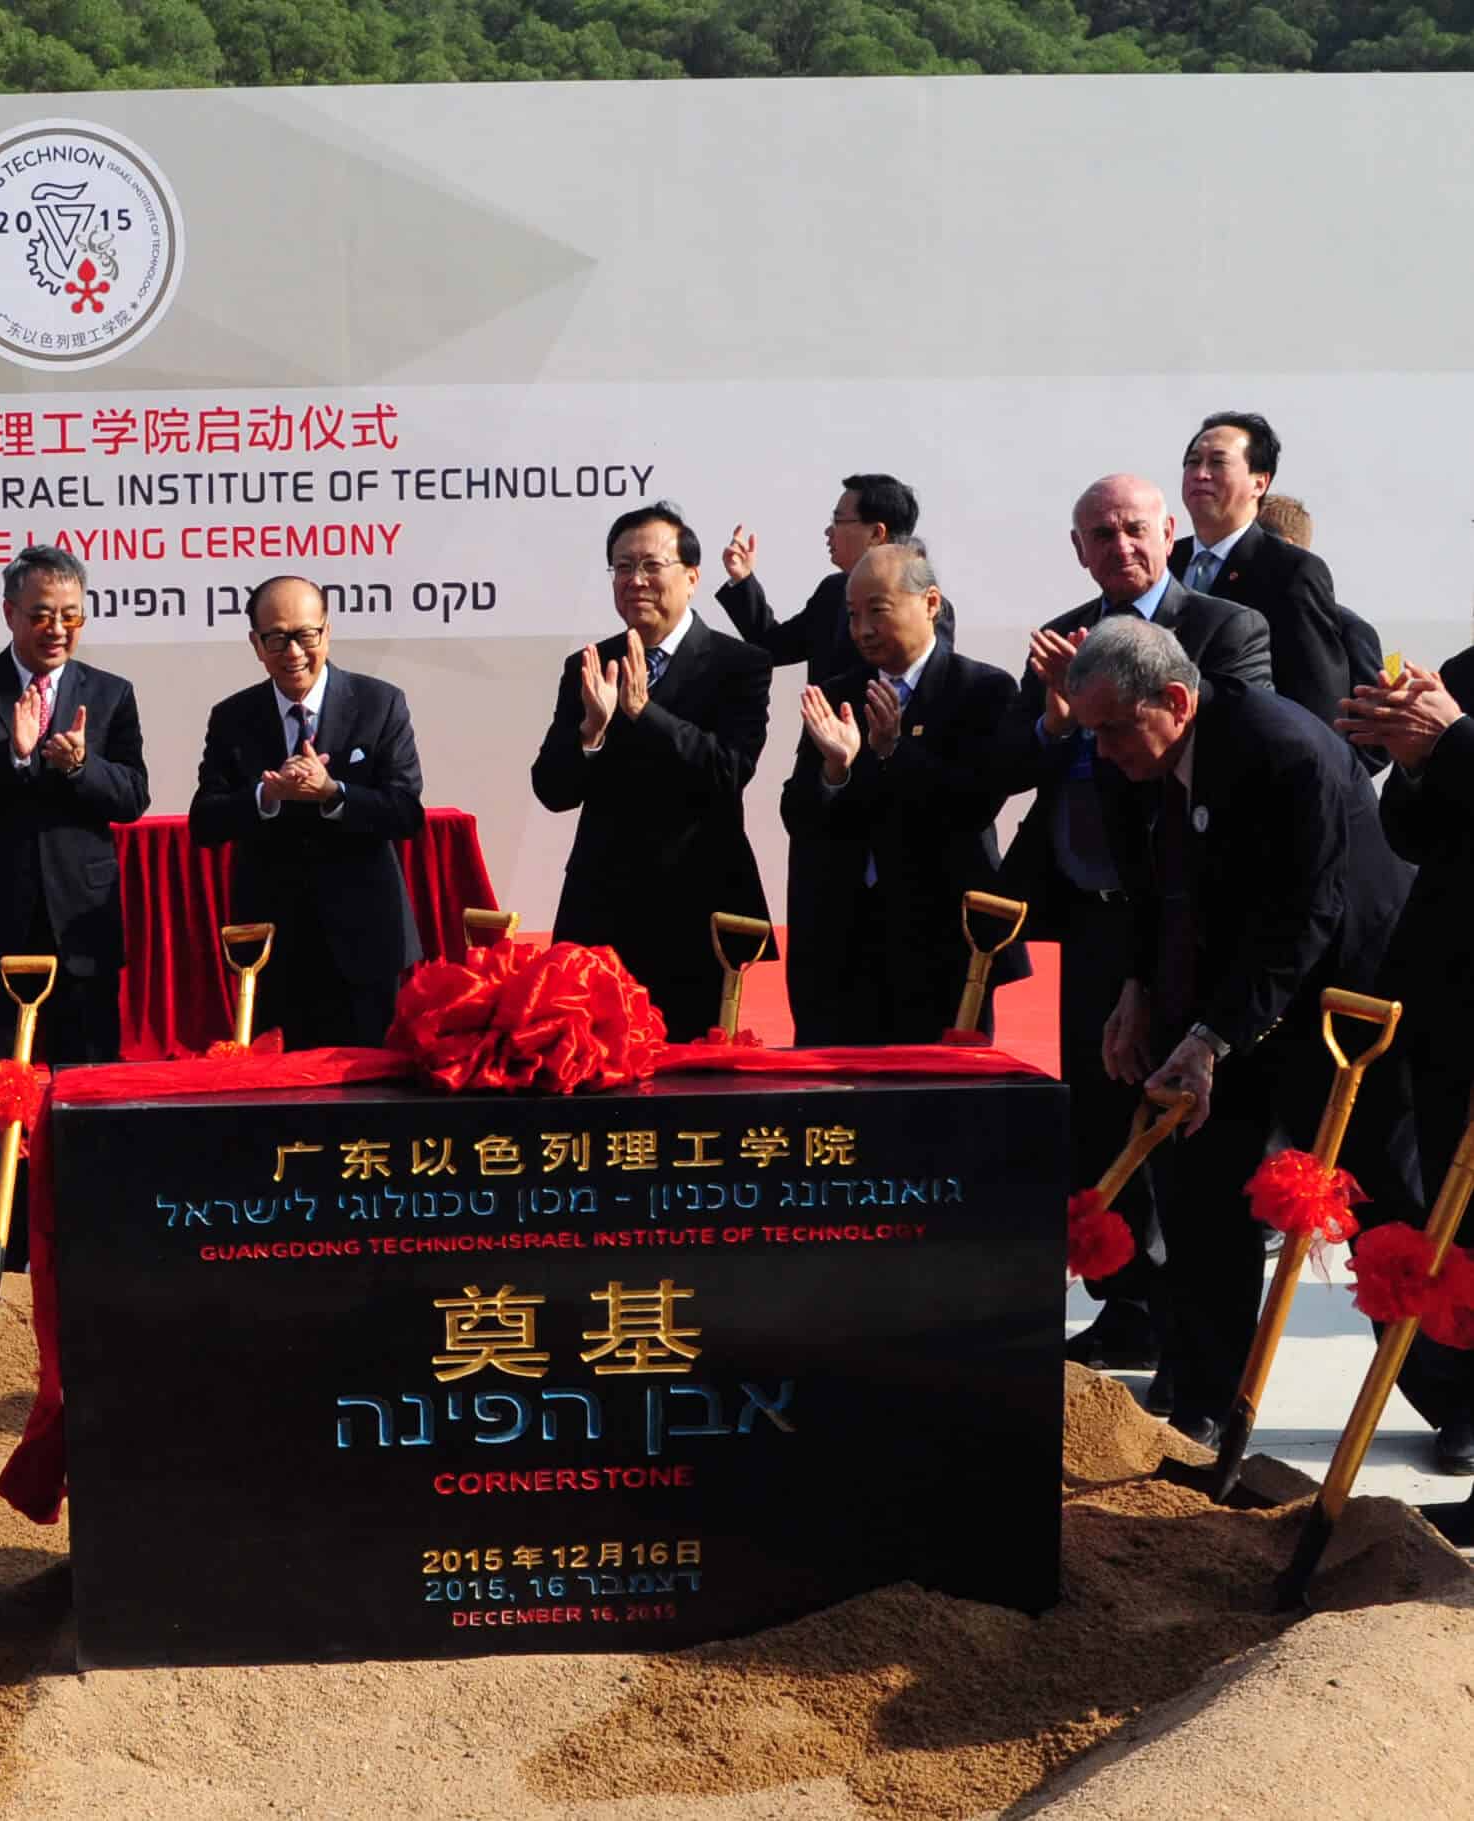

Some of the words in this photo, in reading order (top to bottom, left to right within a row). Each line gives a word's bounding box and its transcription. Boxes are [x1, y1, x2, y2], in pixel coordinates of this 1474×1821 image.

[1, 146, 105, 179] TECHNION
[107, 161, 132, 185] ISRAEL
[131, 182, 158, 223] INSTITUTE
[137, 239, 160, 299] TECHNOLOGY
[118, 471, 314, 507] INSTITUTE
[329, 469, 379, 502] OF
[391, 465, 655, 499] TECHNOLOGY
[180, 523, 402, 560] CEREMONY
[412, 581, 496, 624] טקס
[272, 1125, 858, 1182] 广东以色列理工学院
[156, 1187, 318, 1226] לישראל
[517, 1185, 599, 1222] מכון
[199, 1239, 362, 1262] GUANGDONG
[367, 1231, 586, 1256] TECHNION-ISRAEL
[593, 1226, 716, 1249] INSTITUTE
[722, 1225, 755, 1244] OF
[761, 1221, 927, 1242] TECHNOLOGY
[431, 1279, 702, 1382] 奠基
[336, 1391, 603, 1449] הפינה
[645, 1379, 797, 1456] אבן
[432, 1465, 694, 1496] CORNERSTONE
[529, 1575, 566, 1599] 16
[451, 1605, 583, 1629] DECEMBER
[590, 1605, 619, 1623] 16,
[625, 1602, 677, 1623] 2015
